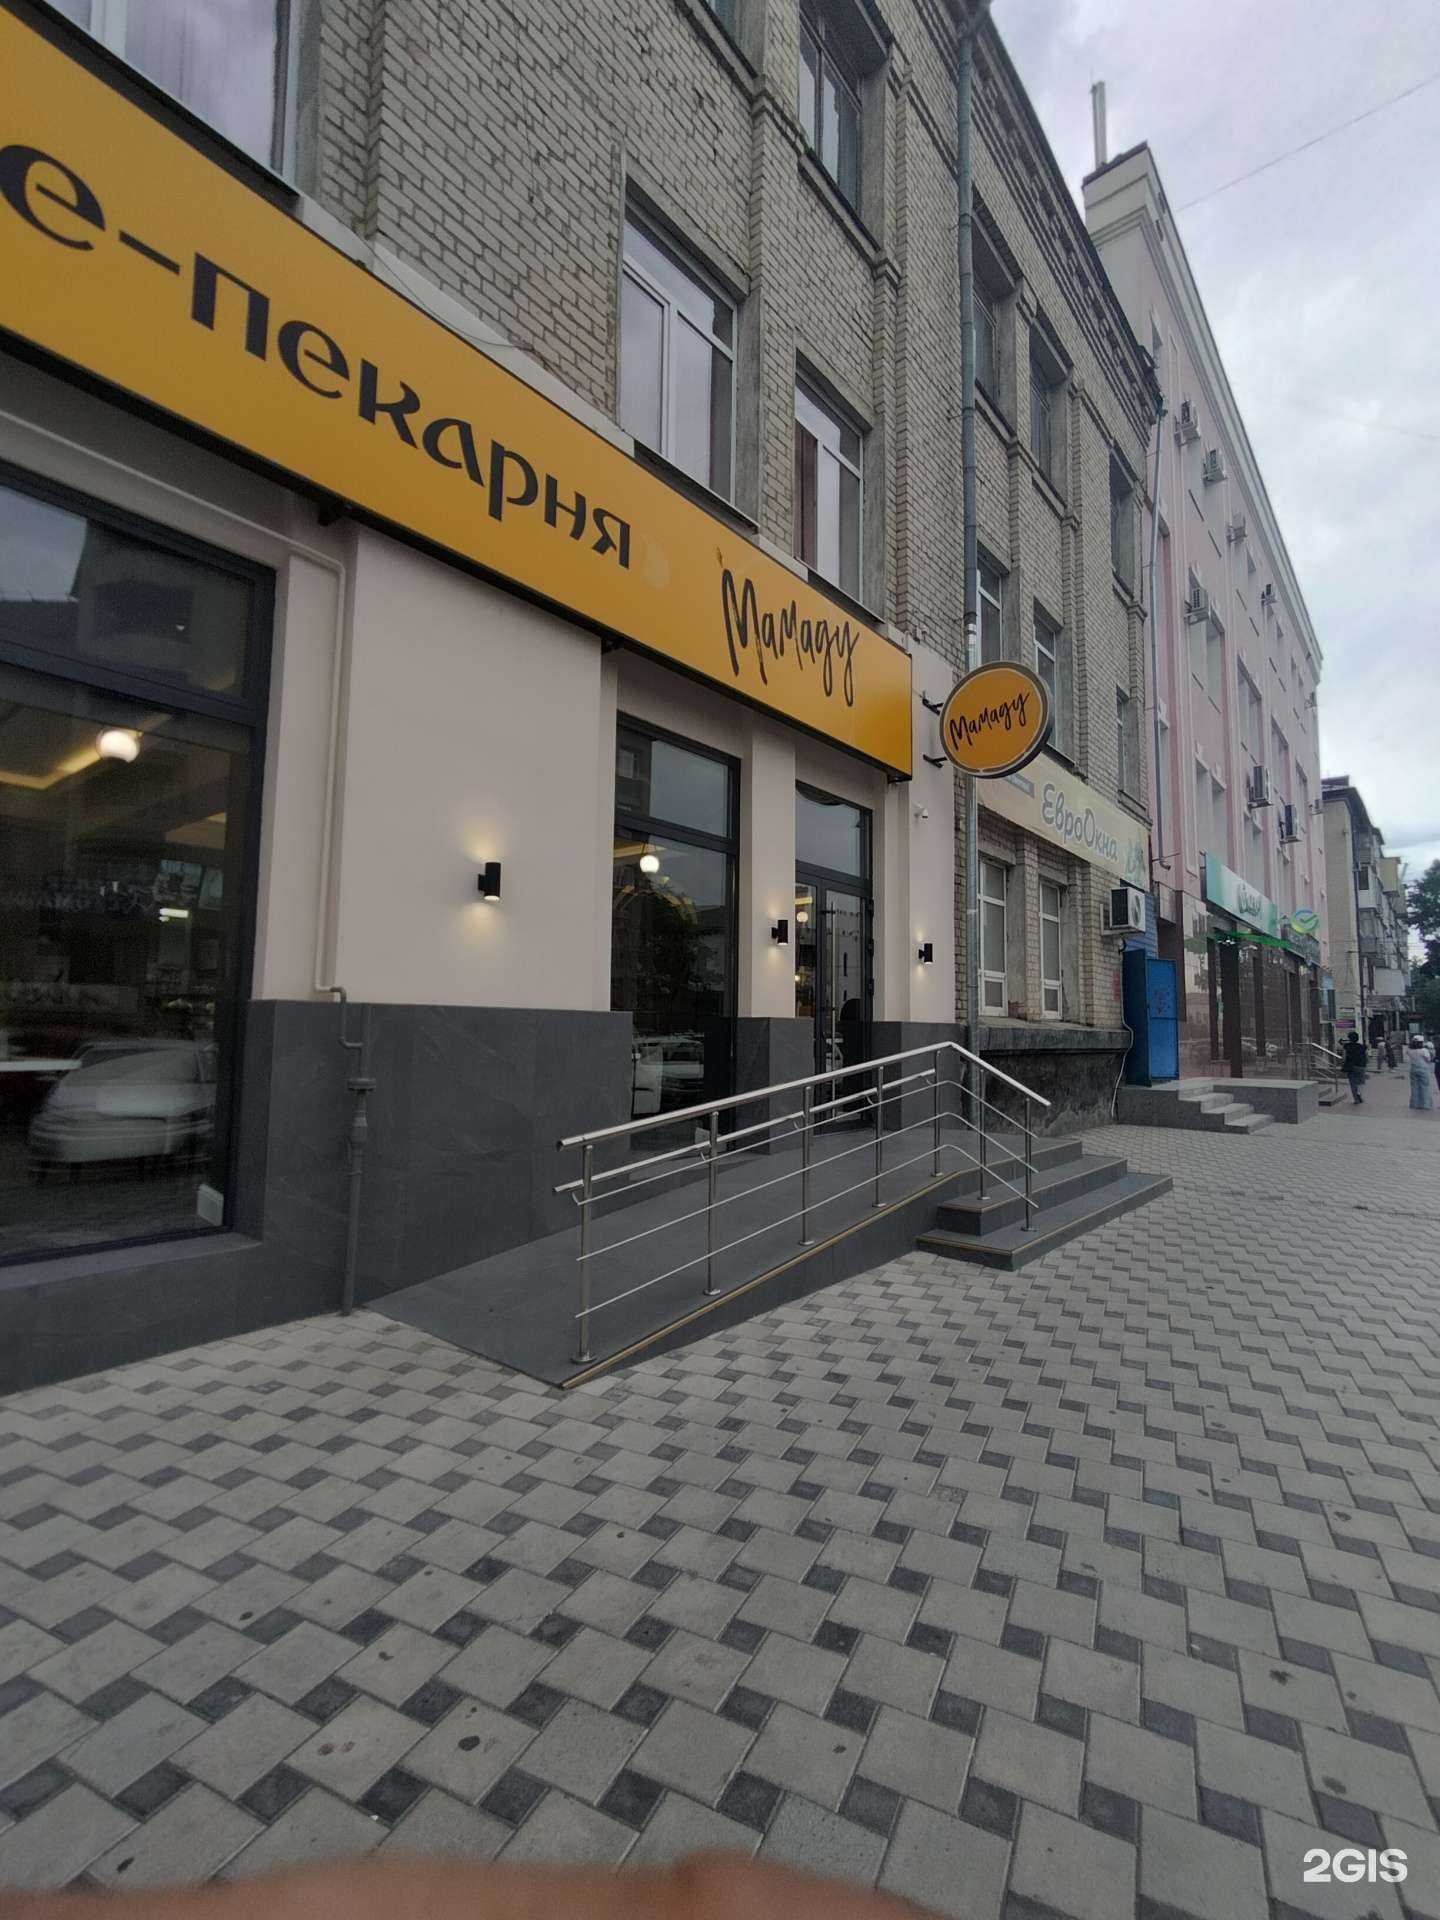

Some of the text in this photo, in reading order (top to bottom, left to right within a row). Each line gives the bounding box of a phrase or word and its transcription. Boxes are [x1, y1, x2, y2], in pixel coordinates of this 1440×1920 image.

[722, 569, 860, 707] Мамаду
[949, 691, 1031, 751] Мамаду
[1042, 783, 1119, 860] ЕвроОкна
